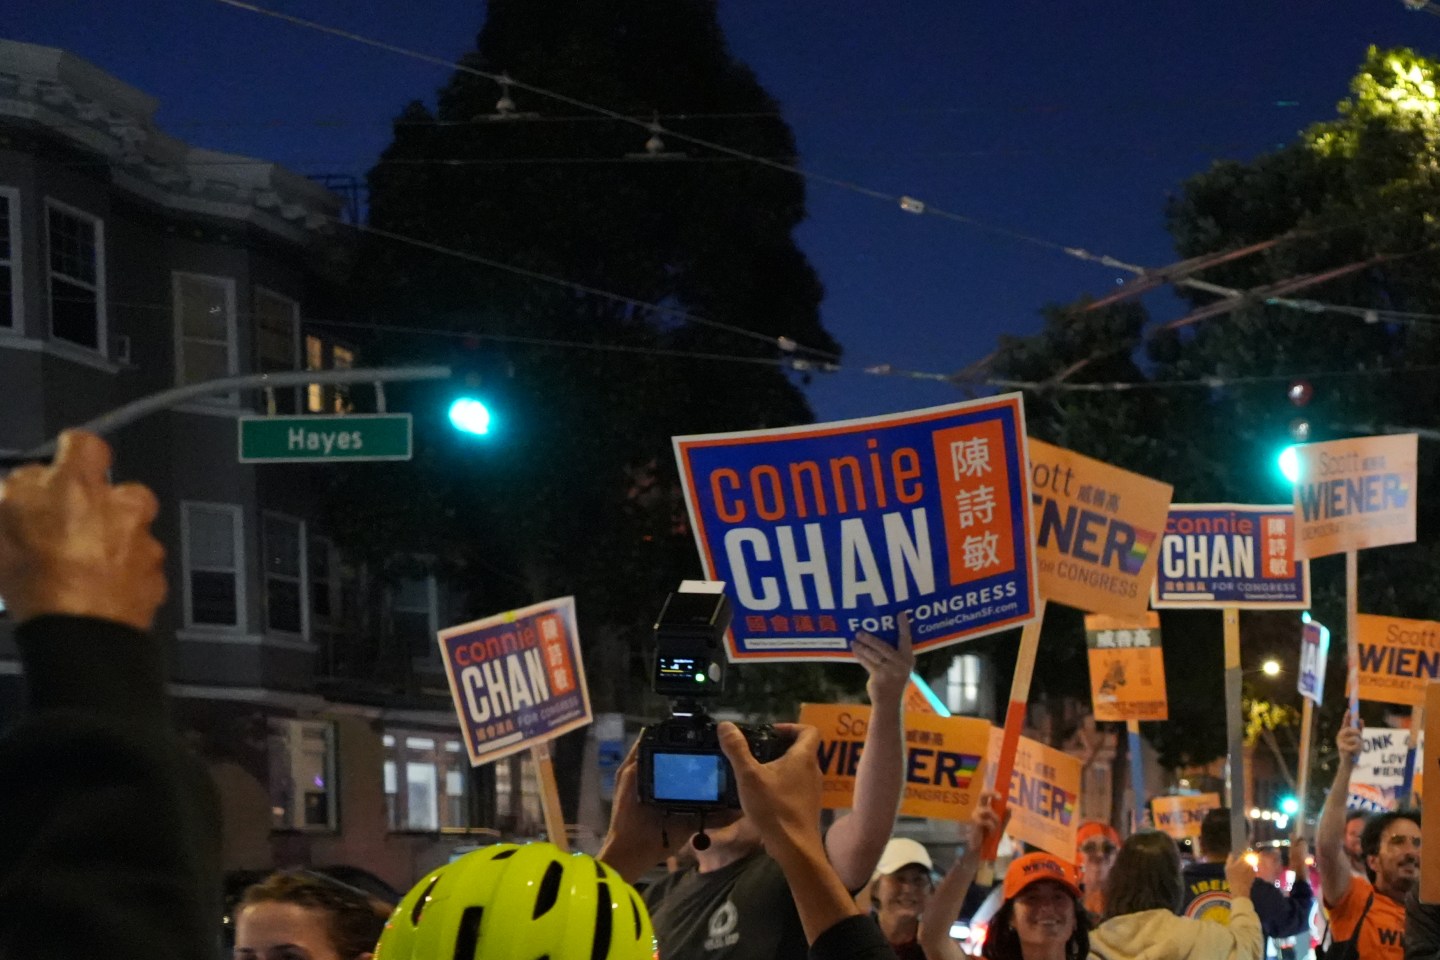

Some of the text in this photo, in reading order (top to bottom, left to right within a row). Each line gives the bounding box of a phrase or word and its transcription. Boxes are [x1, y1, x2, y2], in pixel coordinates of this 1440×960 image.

[287, 427, 363, 455] Hayes
[709, 438, 924, 524] connie
[1030, 462, 1075, 497] ott
[1298, 473, 1406, 522] WIENER
[950, 436, 1001, 572] 陳詩敏
[1165, 512, 1254, 534] connie
[723, 507, 936, 612] CHAN
[1162, 534, 1255, 578] CHAN
[1057, 559, 1138, 599] CONGRESS
[1212, 582, 1234, 591] FOR
[1237, 581, 1297, 592] CONGRESS
[848, 582, 1017, 633] FOR CONGRESS
[918, 601, 1018, 634] ConnieChanSF.com
[455, 623, 536, 667] connie
[1387, 624, 1437, 648] Scott
[461, 647, 549, 723] CHAN
[1361, 733, 1393, 753] ONK
[1381, 753, 1406, 764] LOV
[817, 739, 963, 788] WIEER
[905, 787, 970, 806] ONGRESS
